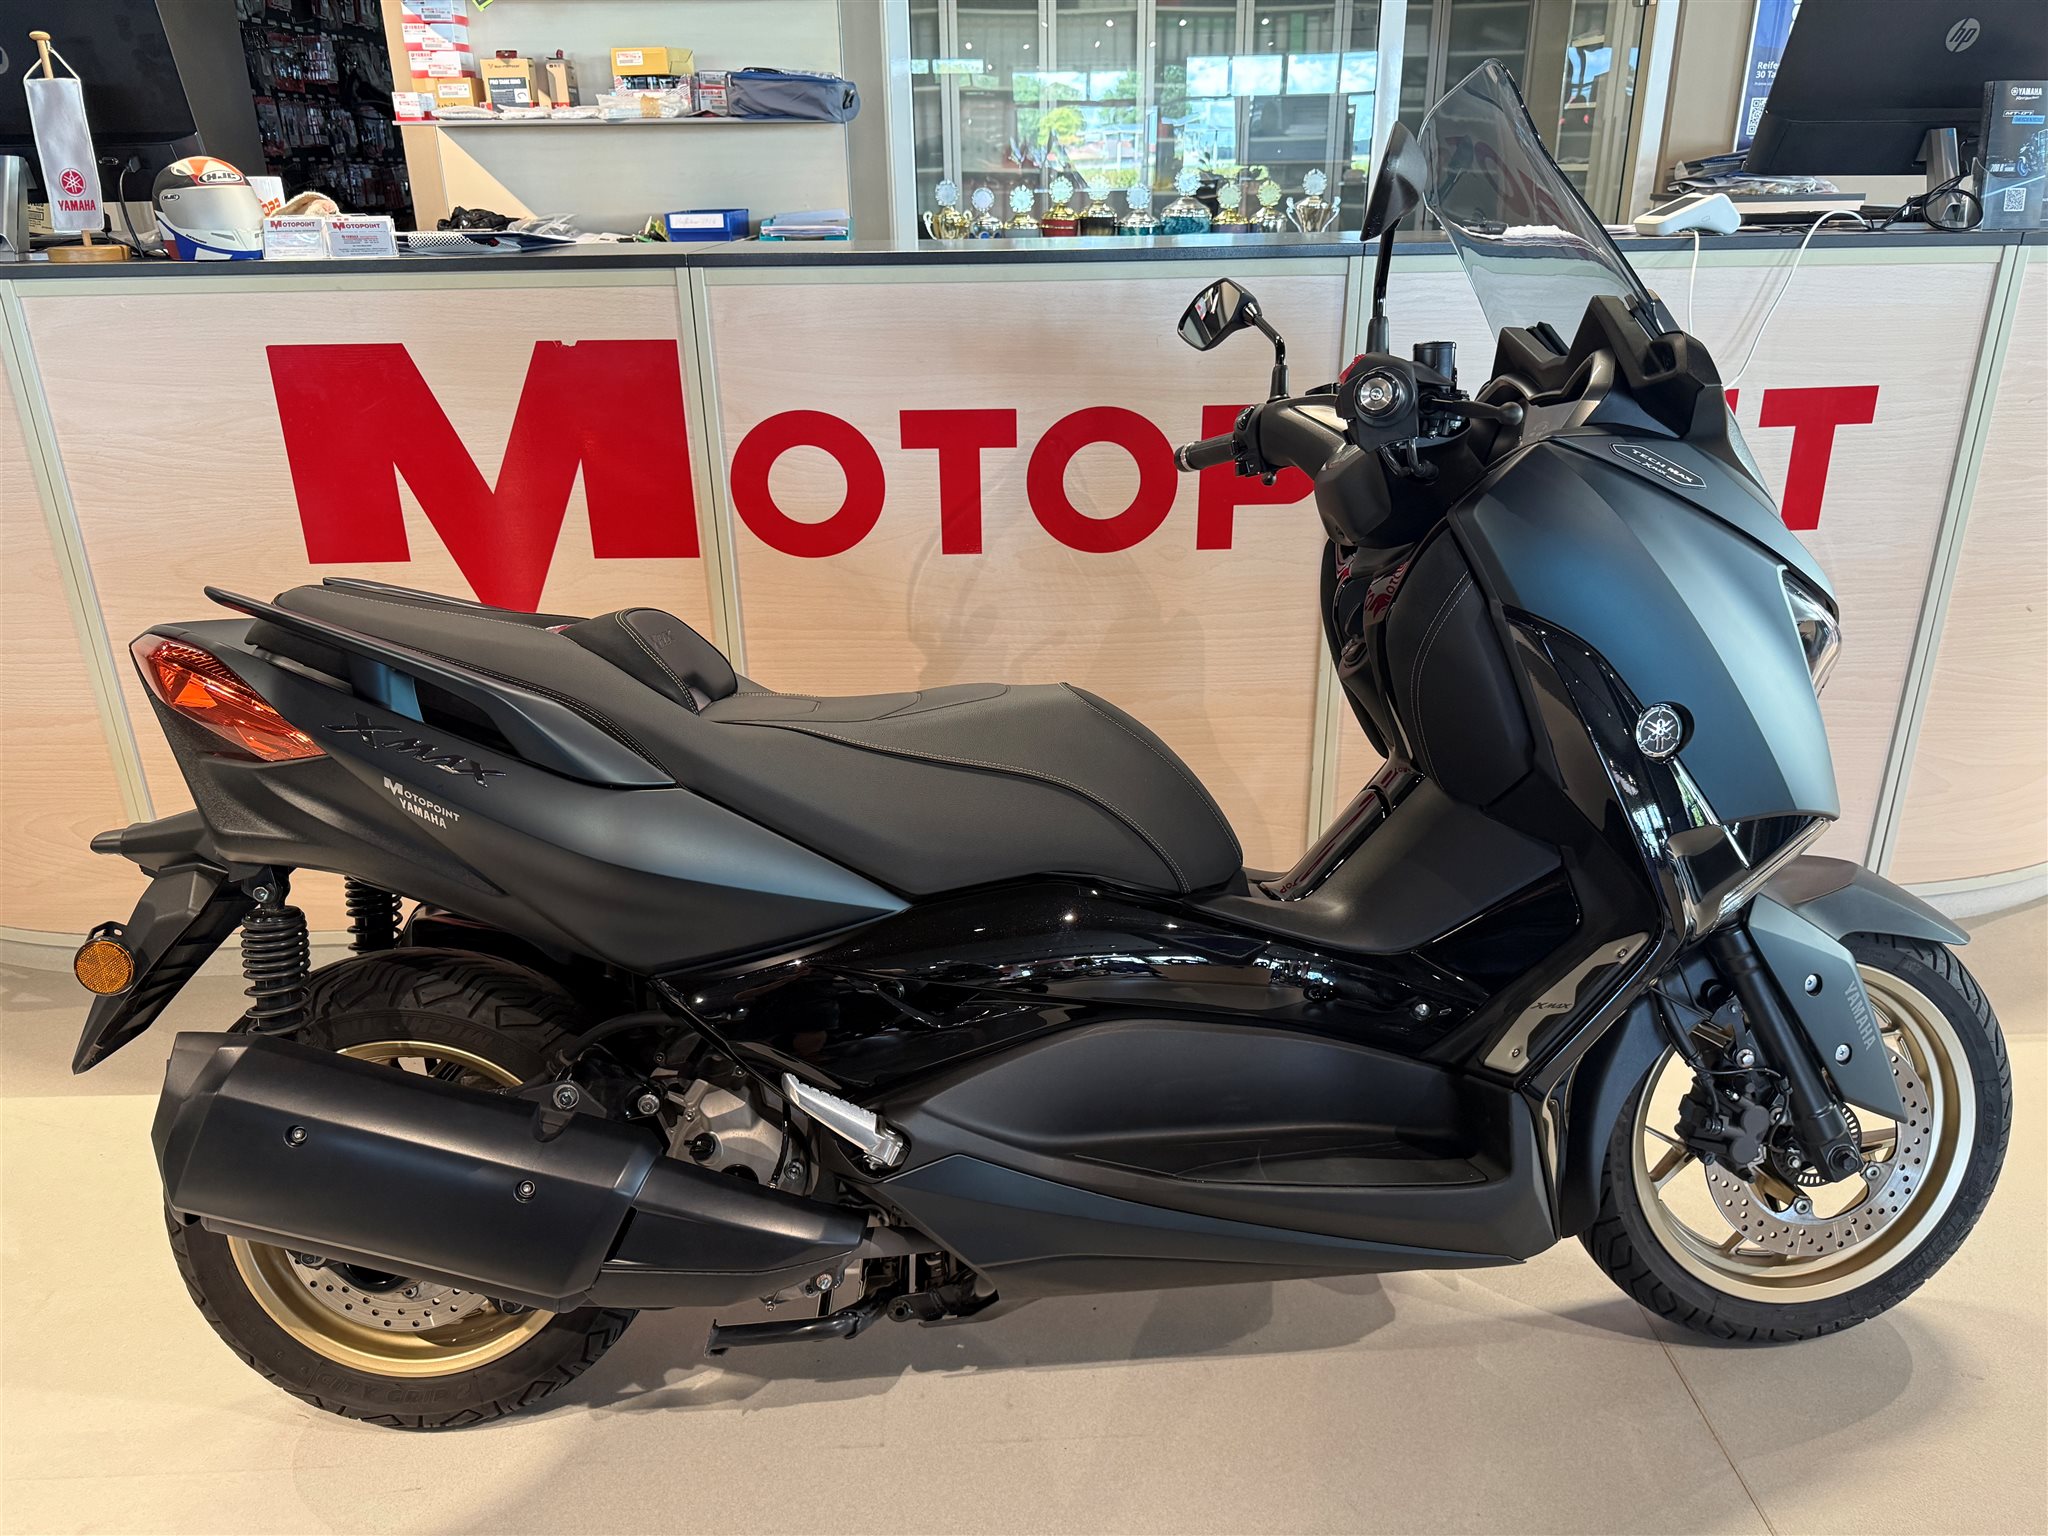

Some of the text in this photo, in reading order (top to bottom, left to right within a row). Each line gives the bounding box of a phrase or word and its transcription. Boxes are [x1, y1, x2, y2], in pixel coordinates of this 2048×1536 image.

[1755, 71, 1766, 79] 30
[2018, 87, 2043, 96] YAMAHA
[206, 173, 236, 181] HJC
[57, 199, 97, 212] YAMAHA
[270, 220, 316, 231] MOTOPOINT
[332, 222, 381, 231] MOTOPOINT
[1632, 448, 1693, 482] TECH MAX
[322, 712, 506, 788] XMAX
[383, 776, 461, 822] MOTOPOINT
[399, 797, 447, 830] YAMAHA
[1530, 1002, 1572, 1010] XMAX
[1844, 980, 1876, 1051] YAMAHA
